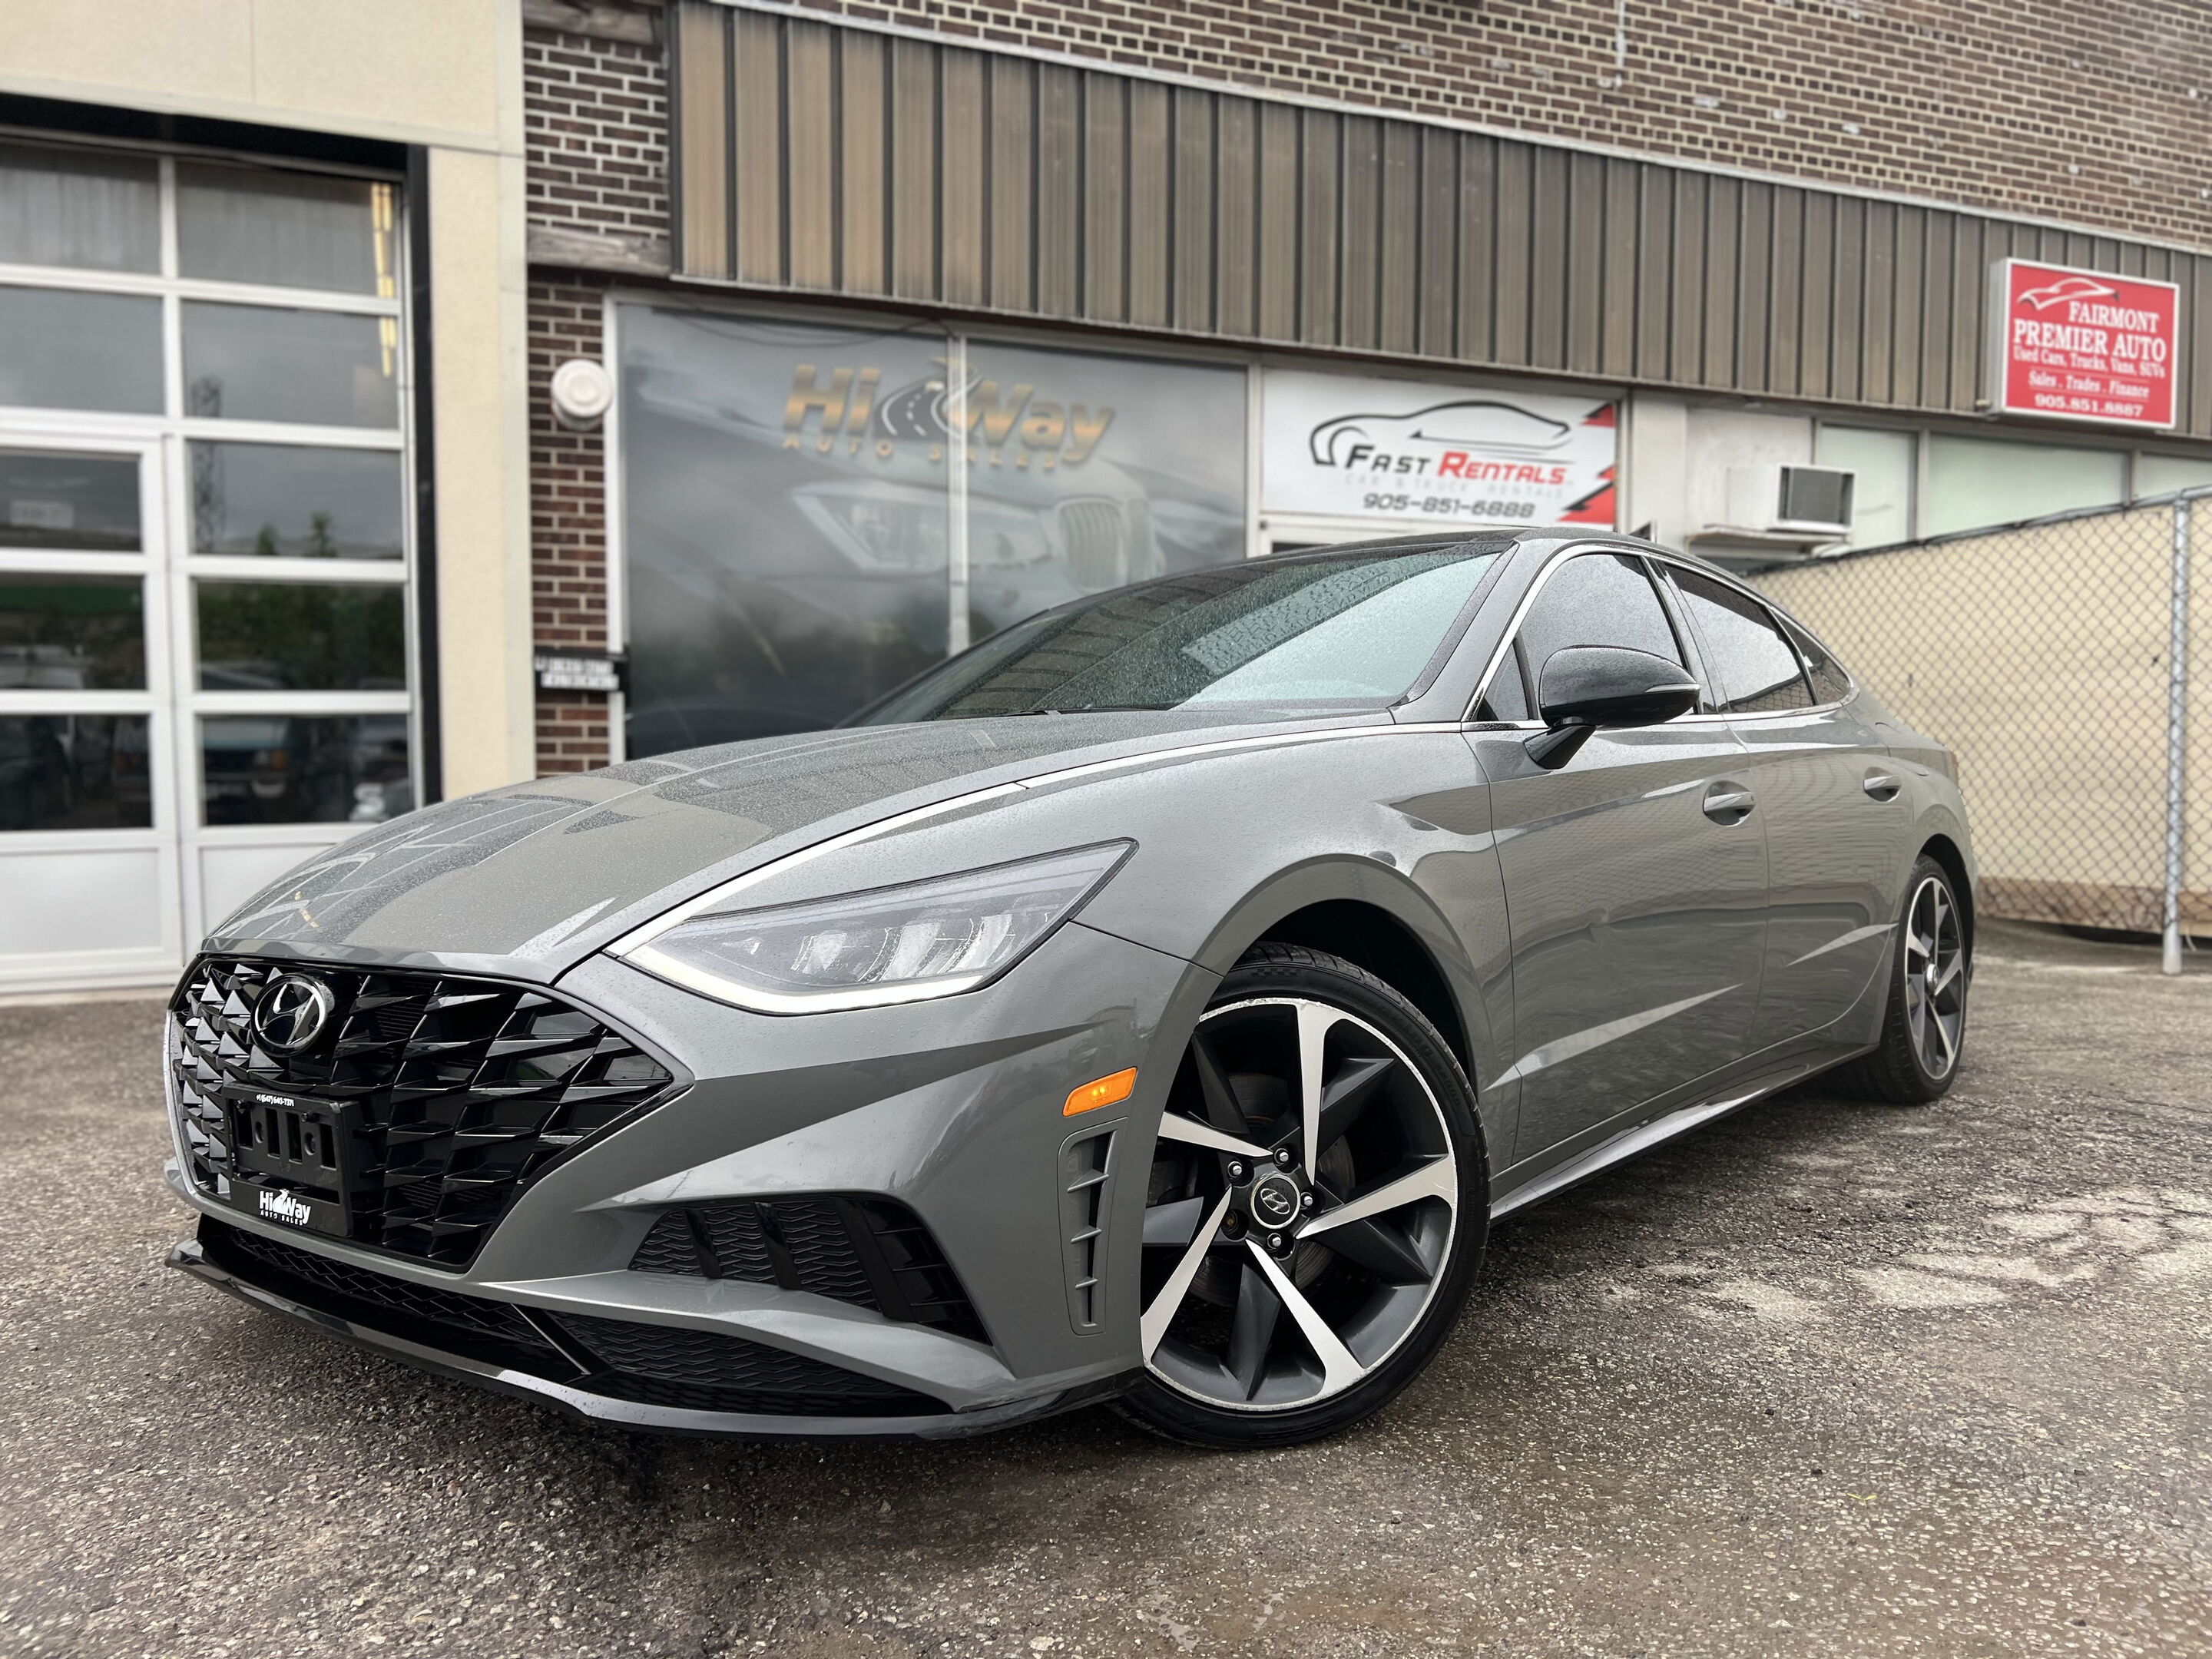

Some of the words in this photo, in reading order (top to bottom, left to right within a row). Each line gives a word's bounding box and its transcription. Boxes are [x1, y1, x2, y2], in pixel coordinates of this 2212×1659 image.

[2069, 300, 2160, 333] FAIRMONT
[2013, 319, 2108, 356] PREMIER
[2113, 333, 2167, 363] AUTO
[2014, 346, 2039, 363] Used
[2029, 369, 2057, 387] Sales
[2065, 374, 2101, 393] Trades
[2109, 379, 2150, 398] Finance
[782, 435, 894, 459] AUTO
[1346, 443, 1432, 475] FAST
[1437, 450, 1568, 485] RENTALS
[1363, 492, 1536, 518] 905-851-6888
[260, 1210, 278, 1219] AUTO
[281, 1214, 303, 1226] SALES
